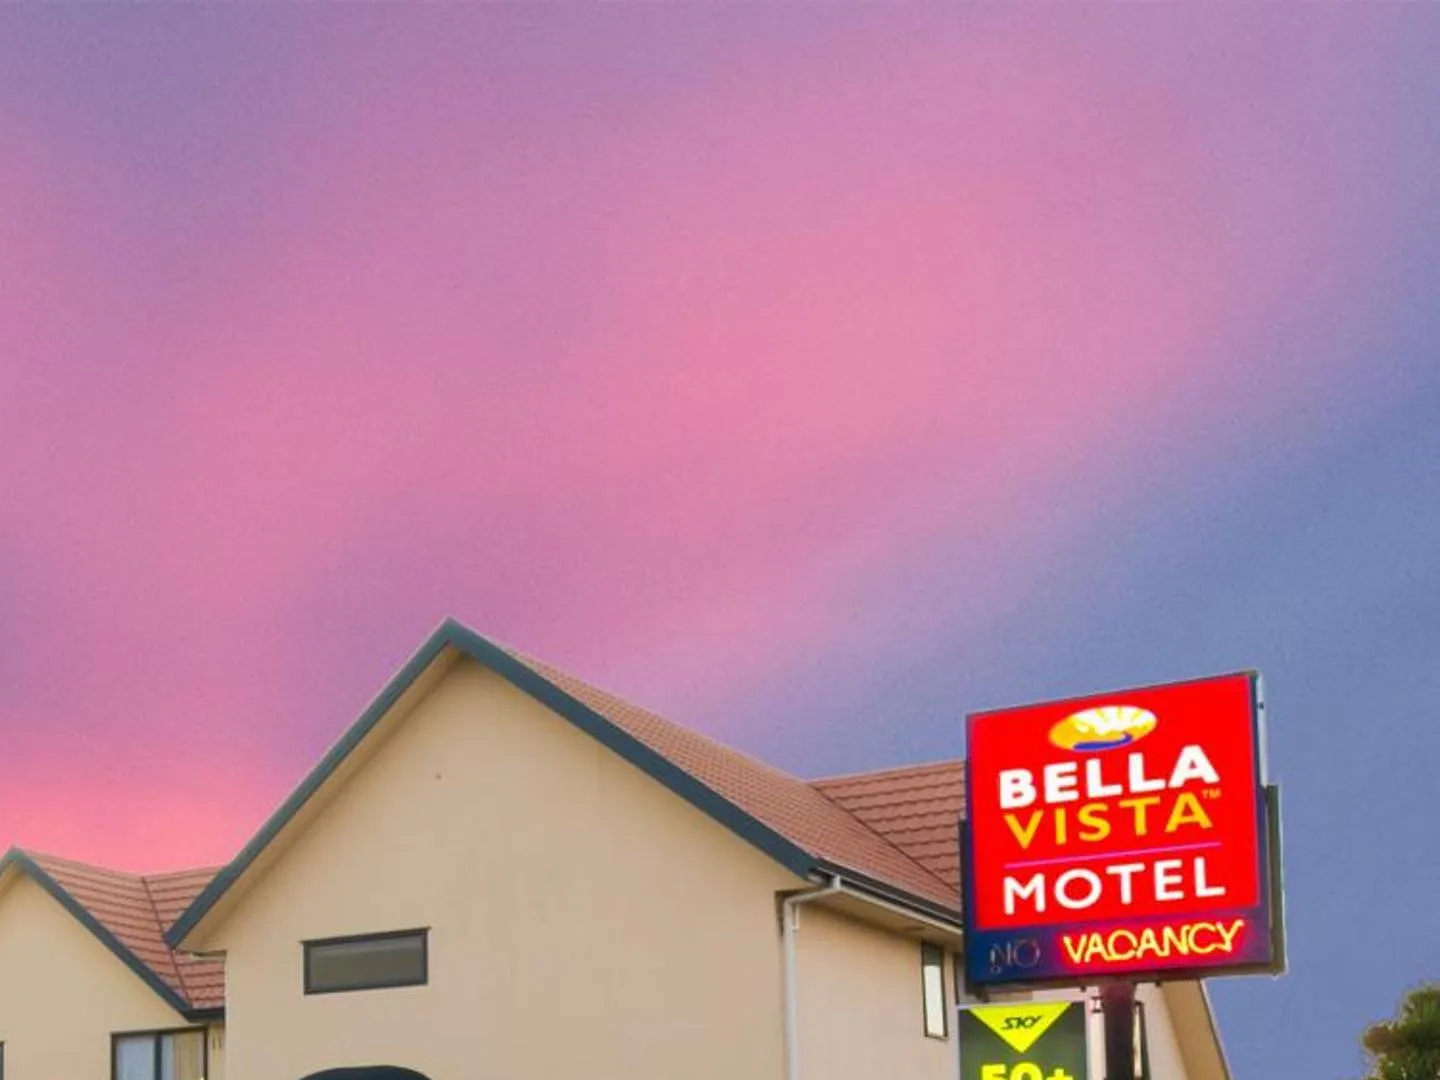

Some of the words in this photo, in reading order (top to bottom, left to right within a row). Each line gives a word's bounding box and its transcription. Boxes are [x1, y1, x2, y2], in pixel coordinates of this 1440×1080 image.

[999, 744, 1220, 809] BELLA
[1004, 792, 1213, 849] VISTA
[1004, 857, 1226, 915] MOTEL
[990, 939, 1041, 969] NO
[1063, 920, 1244, 963] VACANCY
